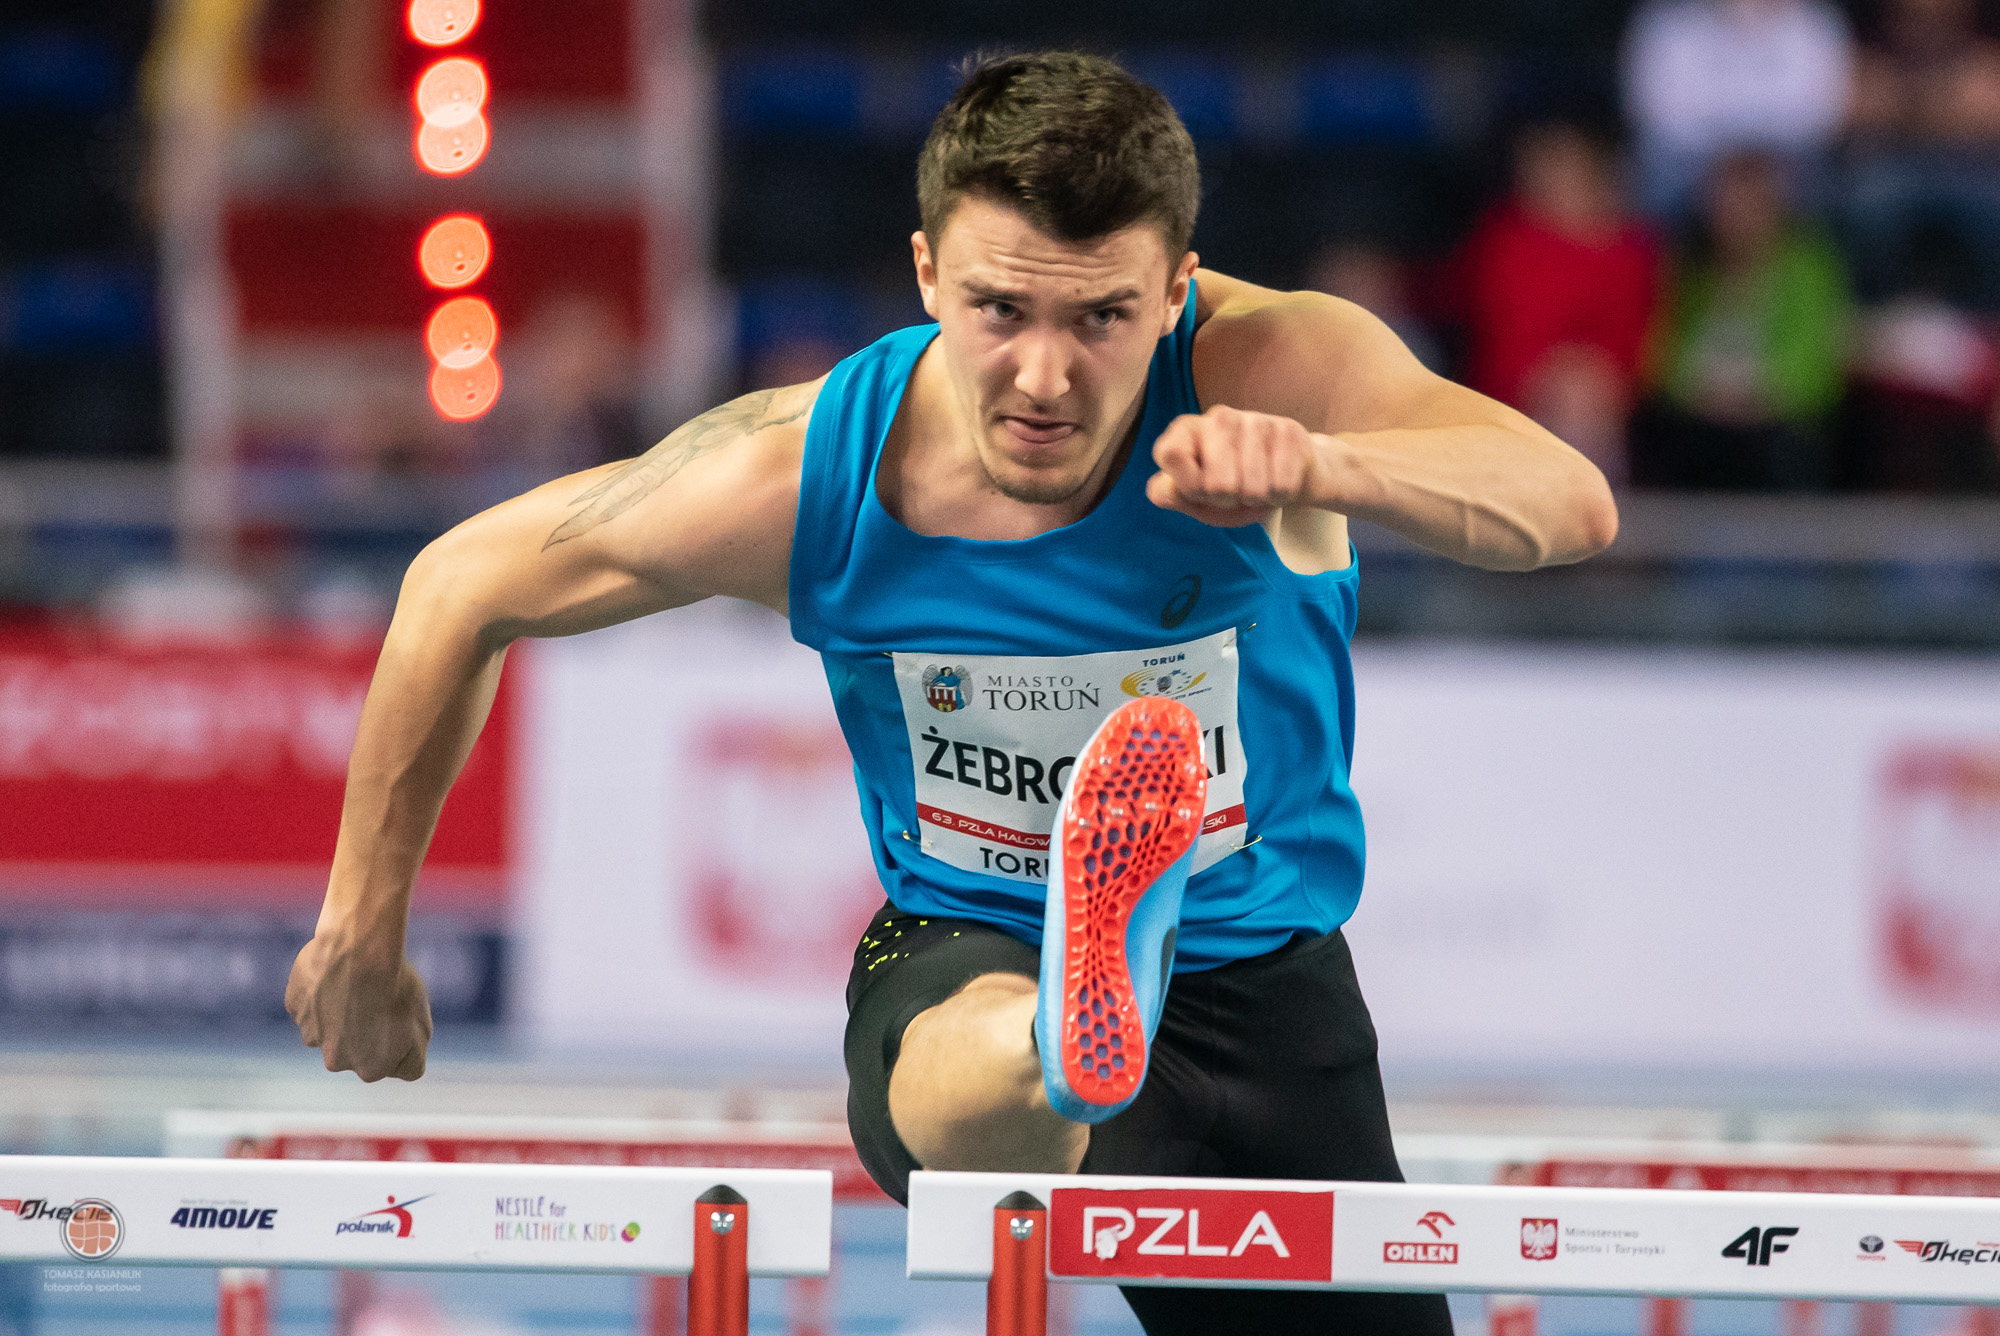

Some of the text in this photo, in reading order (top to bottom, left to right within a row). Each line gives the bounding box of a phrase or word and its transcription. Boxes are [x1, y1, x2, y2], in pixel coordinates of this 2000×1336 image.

[1142, 651, 1186, 668] TORUŃ
[988, 675, 1074, 687] MIASTO
[983, 682, 1101, 711] TORUŃ
[958, 819, 995, 837] PZLA
[998, 830, 1051, 847] HALOW
[550, 1202, 567, 1217] for
[170, 1207, 278, 1230] 4MOVE
[336, 1219, 395, 1235] polanik
[583, 1222, 617, 1242] KIDS
[1083, 1206, 1291, 1258] PZLA
[1565, 1227, 1639, 1238] Ministerstwo
[1386, 1245, 1456, 1262] ORLEN
[1614, 1244, 1666, 1256] Turystyki
[1720, 1226, 1800, 1266] 4F
